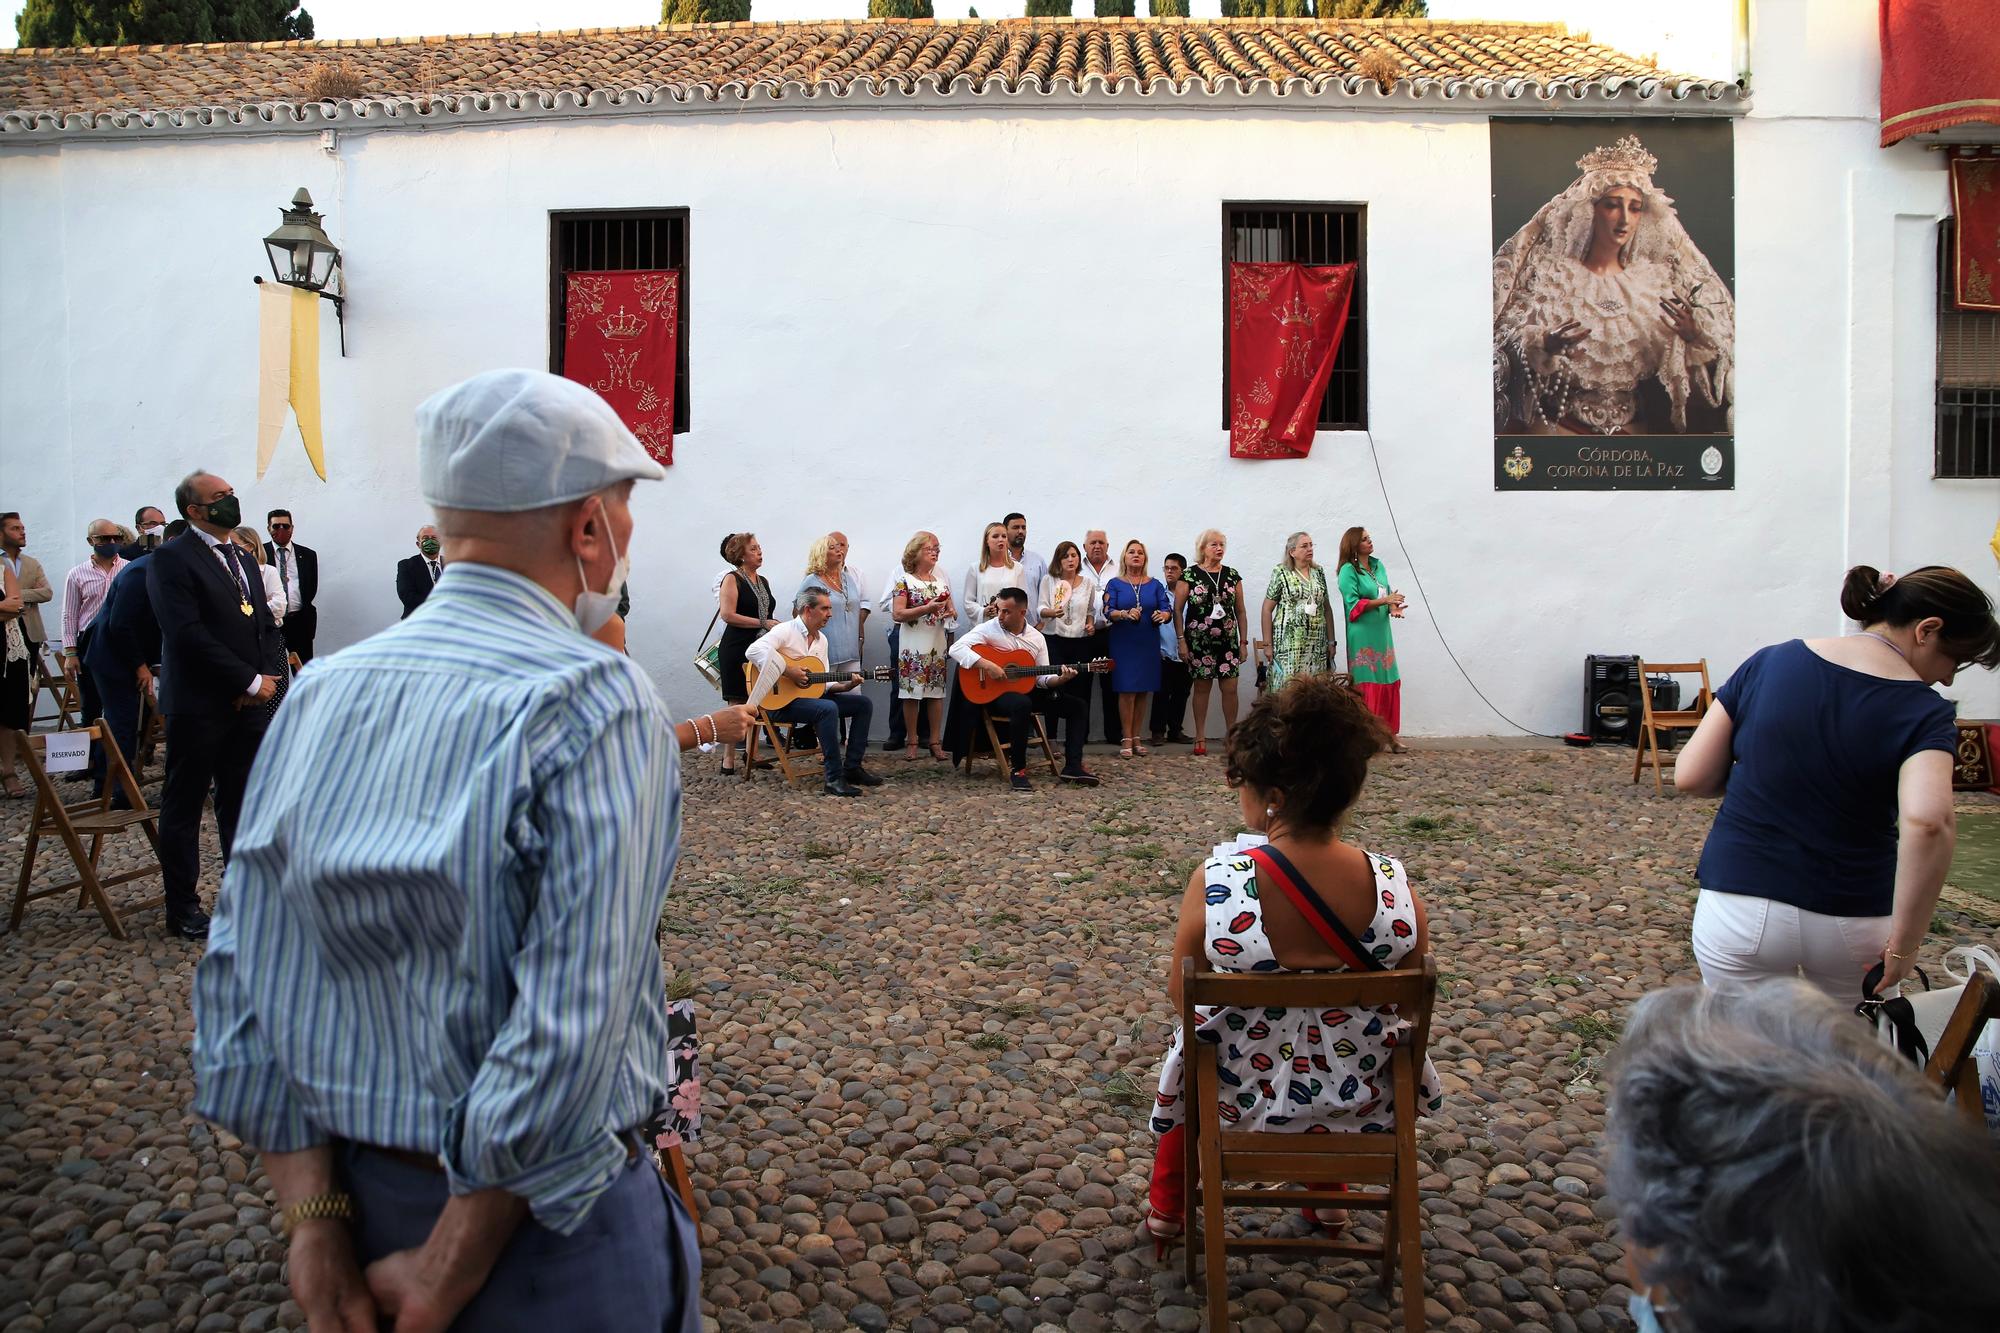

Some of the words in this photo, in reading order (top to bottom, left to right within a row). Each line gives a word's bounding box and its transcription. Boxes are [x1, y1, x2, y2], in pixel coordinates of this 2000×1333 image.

[1547, 465, 1609, 477] CORONA
[1614, 465, 1632, 477] DE
[1636, 465, 1653, 477] LA
[1657, 463, 1684, 477] PAZ
[51, 750, 86, 758] RESERVADO
